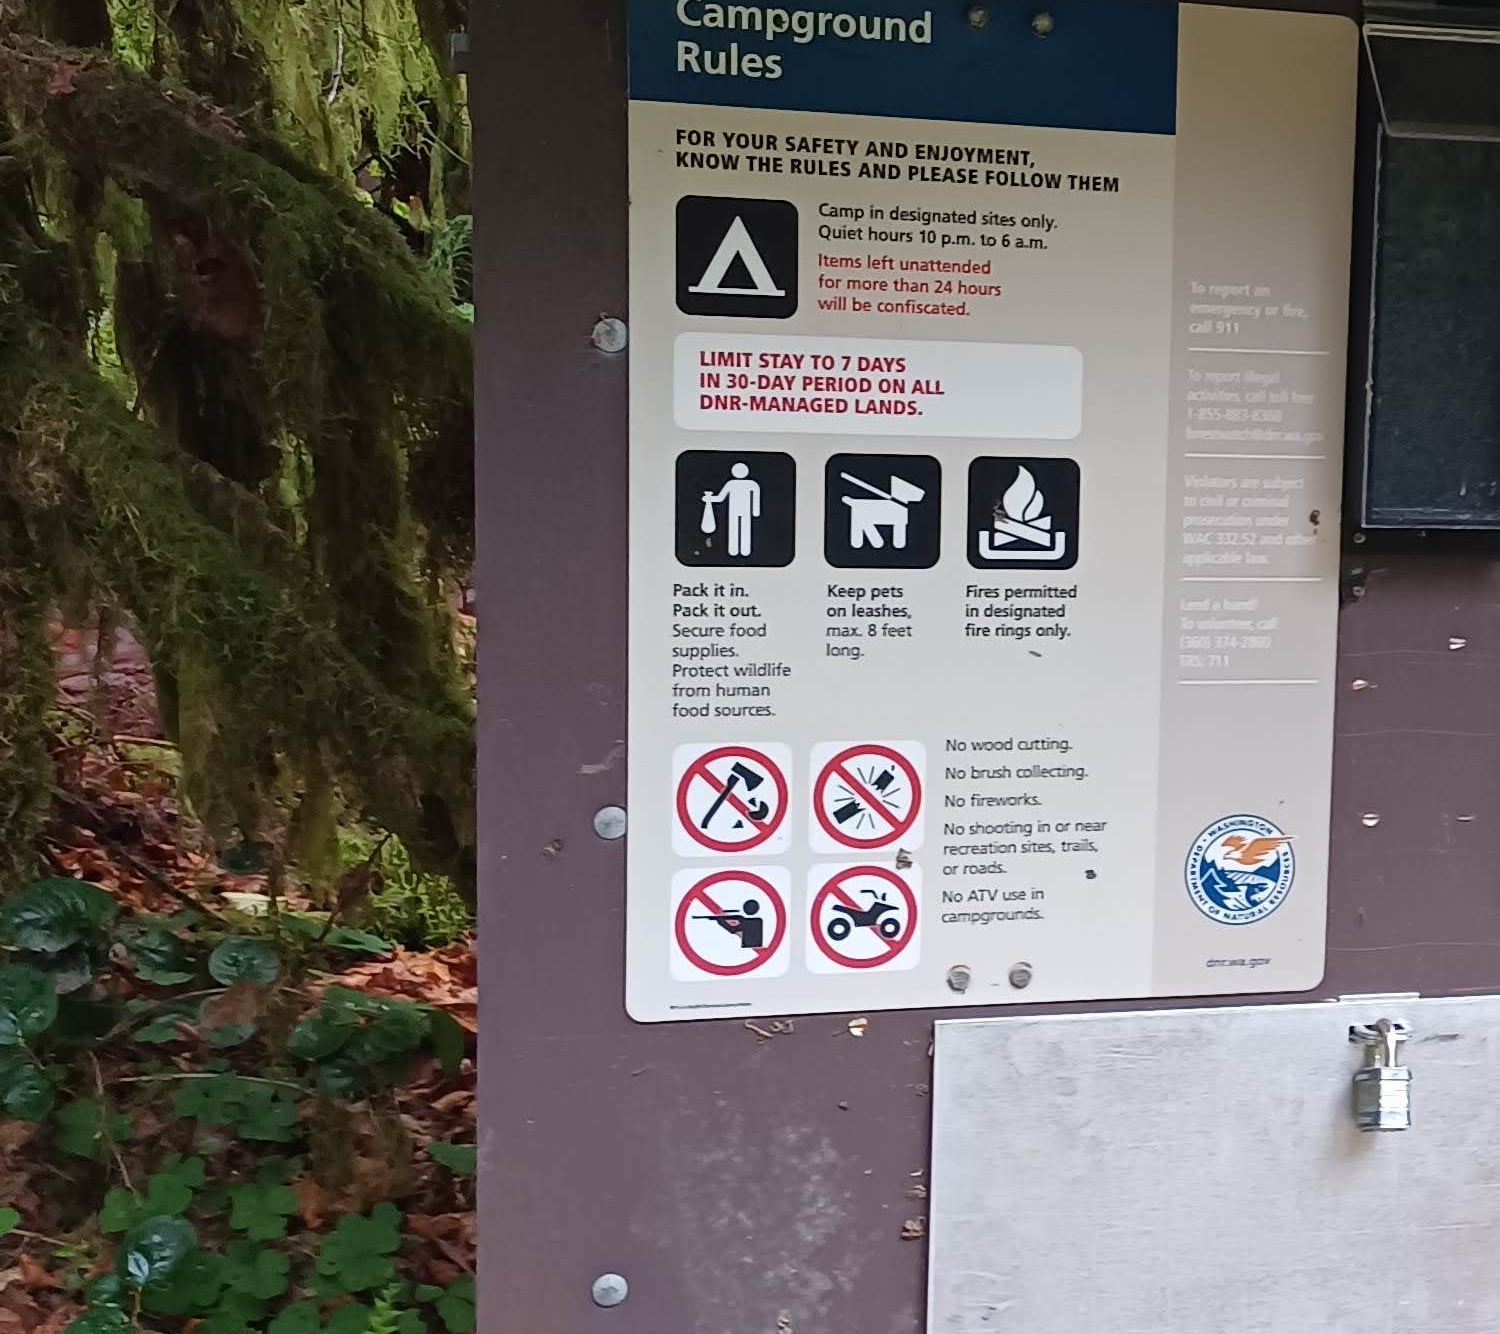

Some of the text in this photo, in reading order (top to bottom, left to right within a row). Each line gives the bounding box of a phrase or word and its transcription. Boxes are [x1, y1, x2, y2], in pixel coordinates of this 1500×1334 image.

[678, 41, 782, 78] Rules
[677, 129, 1034, 168] FOR YOUR SAFETY AND ENJOYMENT,
[676, 151, 1119, 192] KNOW THE RULES AND PLEASE FOLLOW THEM
[819, 203, 1057, 232] Camp in designated sites only.
[819, 225, 1047, 249] Quiet hours 10 p.m. to 6 a.m.
[819, 254, 990, 274] Items left unattended
[819, 275, 1001, 296] for more than 24 hours
[818, 296, 969, 315] will be confiscated.
[1189, 321, 1239, 334] call 911
[700, 351, 905, 372] LIMIT STAY TO 7 DAYS
[701, 373, 944, 395] IN 30-DAY PERIOD ON ALL
[700, 395, 922, 415] DNR-MANAGED LANDS.
[673, 583, 748, 597] Pack it in.
[828, 585, 903, 601] Keep pets
[966, 585, 1077, 601] Fires permitted
[673, 603, 761, 617] Pack it out.
[827, 604, 911, 619] on leashes,
[966, 604, 1065, 620] in designated
[673, 623, 766, 637] Secure food
[826, 623, 912, 637] max. 8 feet
[965, 623, 1071, 640] fire rings only.
[673, 644, 738, 660] supplies.
[826, 643, 864, 660] long.
[673, 663, 791, 677] Protect wildlife
[672, 683, 770, 697] from human
[673, 703, 776, 717] food sources.
[946, 738, 1072, 753] No wood cutting.
[946, 765, 1088, 780] No brush collecting.
[945, 793, 1042, 807] No fireworks.
[944, 820, 1107, 837] No shooting in or near
[944, 839, 1098, 855] recreation sites, trails,
[943, 861, 1007, 875] or roads.
[943, 888, 1044, 903] No ATV use in
[942, 907, 1044, 925] campgrounds.
[1208, 906, 1220, 915] OF
